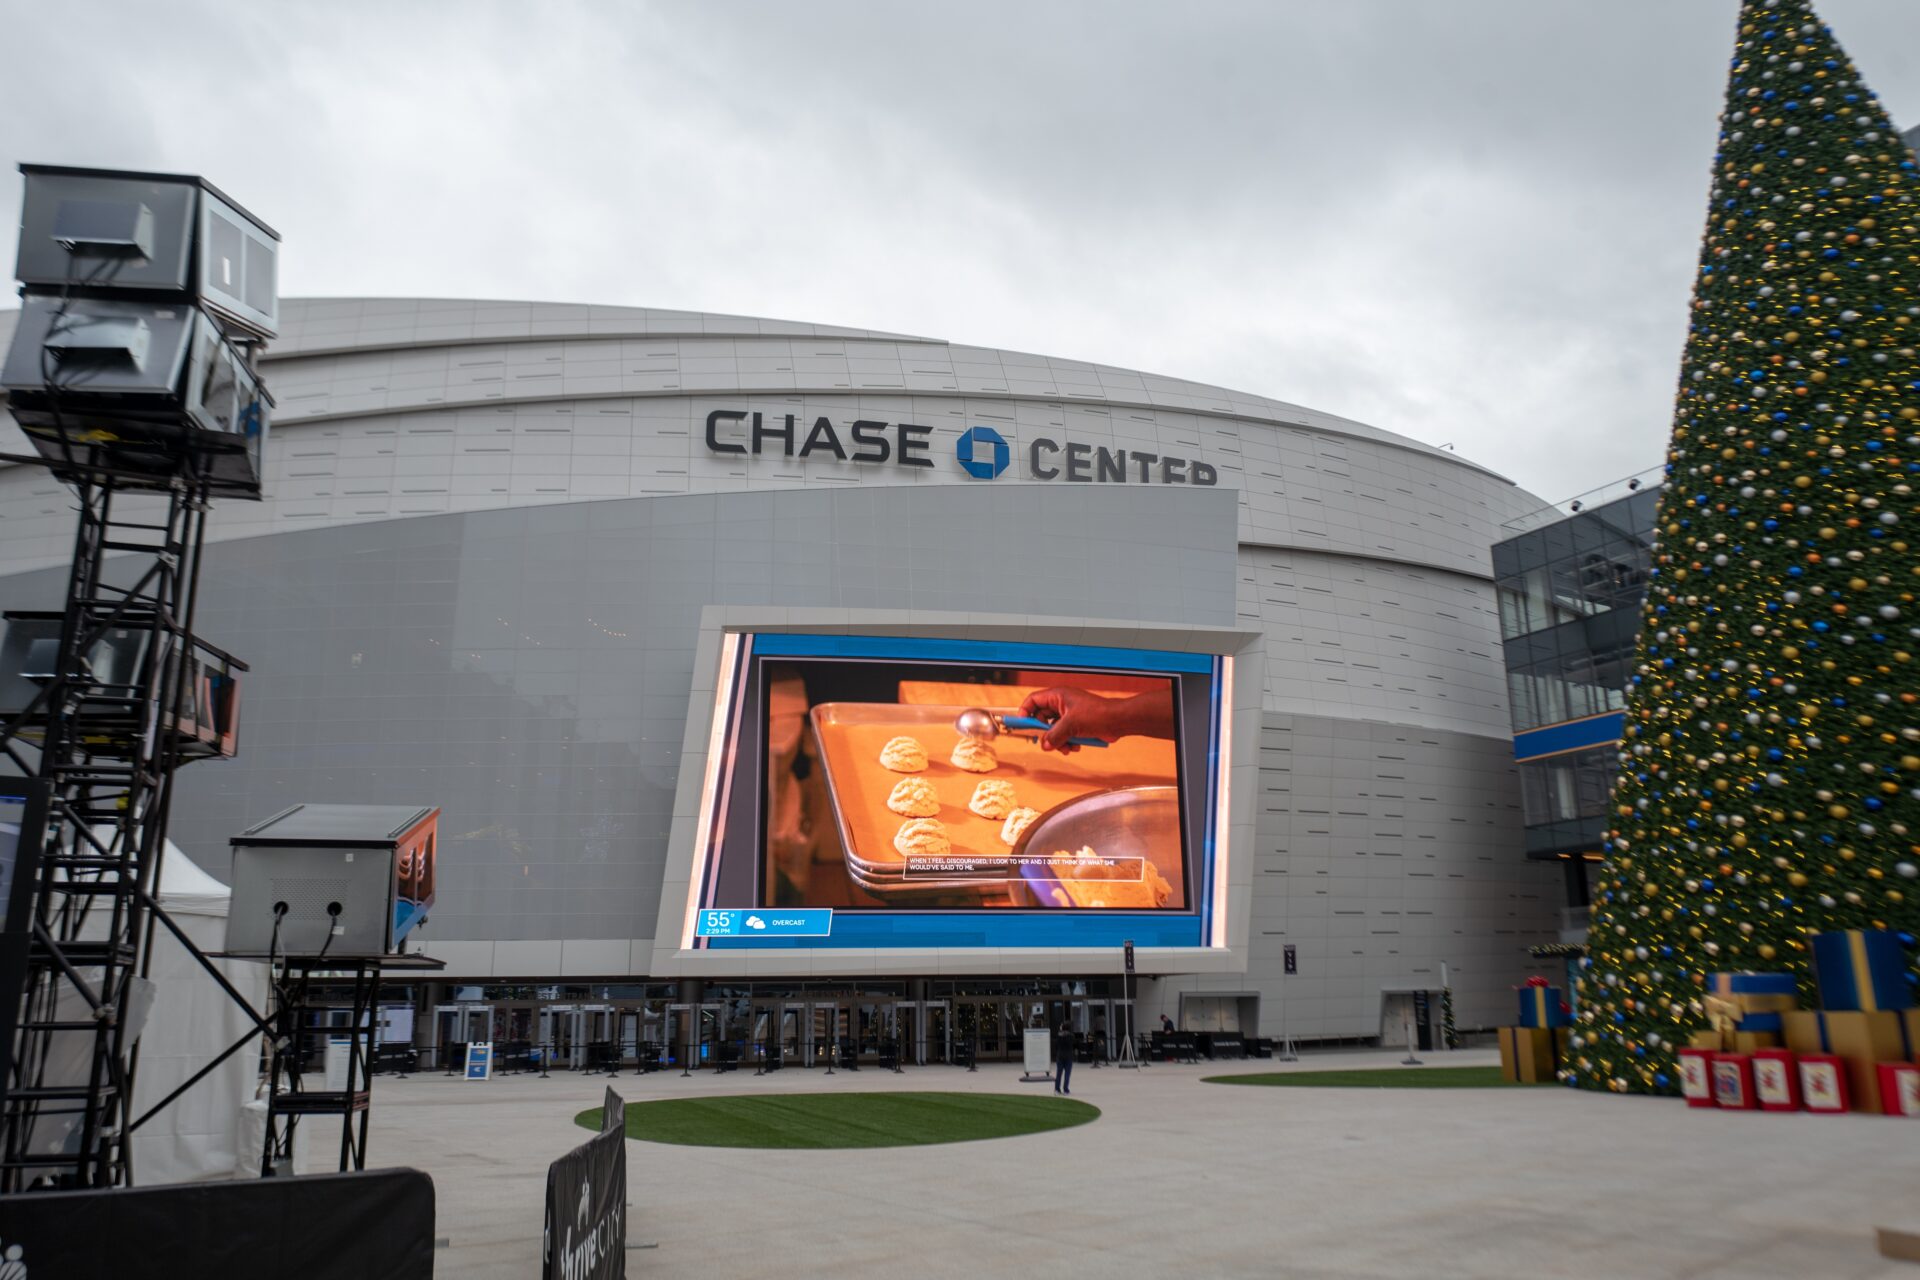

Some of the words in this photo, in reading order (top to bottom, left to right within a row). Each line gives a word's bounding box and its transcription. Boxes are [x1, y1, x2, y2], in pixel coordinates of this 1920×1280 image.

[705, 409, 935, 468] CHASE
[561, 1225, 597, 1280] thrive
[598, 1202, 621, 1259] CITY
